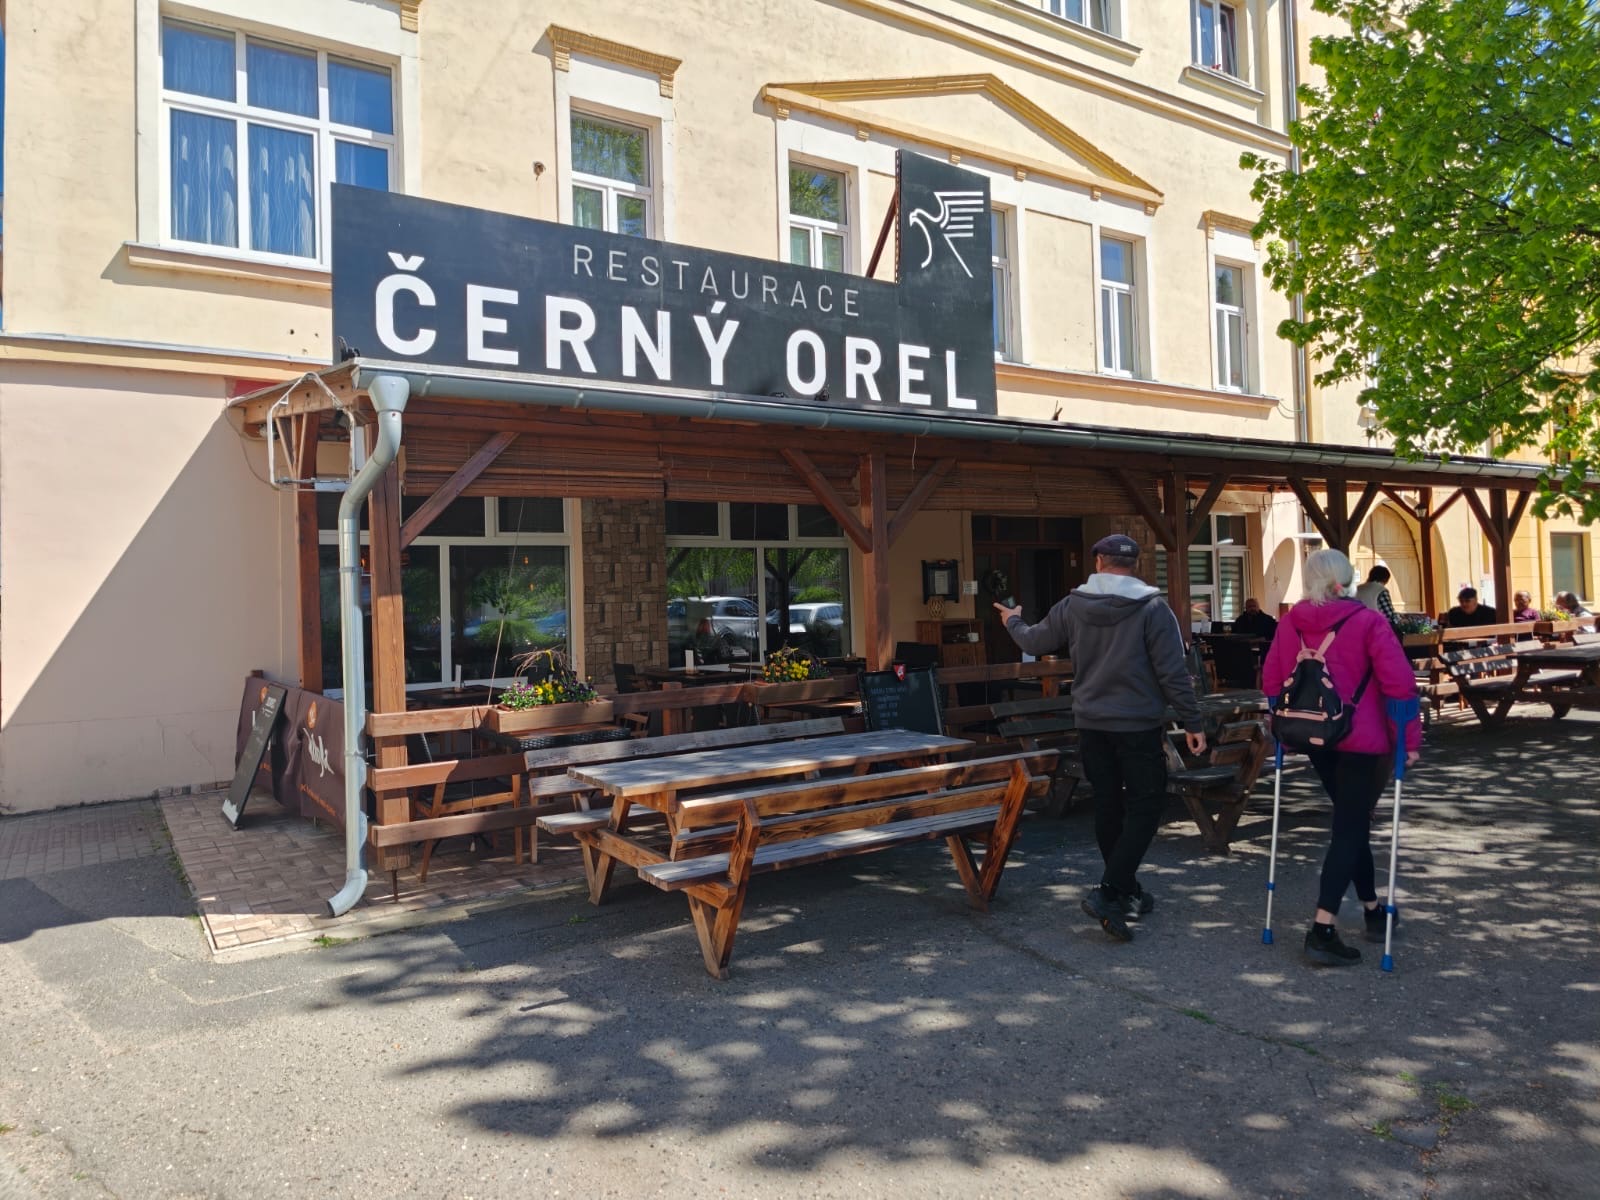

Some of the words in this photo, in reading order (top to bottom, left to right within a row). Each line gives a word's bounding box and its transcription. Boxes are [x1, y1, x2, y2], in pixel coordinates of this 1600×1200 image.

[375, 251, 740, 386] ČERNÝ
[786, 329, 978, 410] OREL
[573, 243, 861, 318] RESTAURACE
